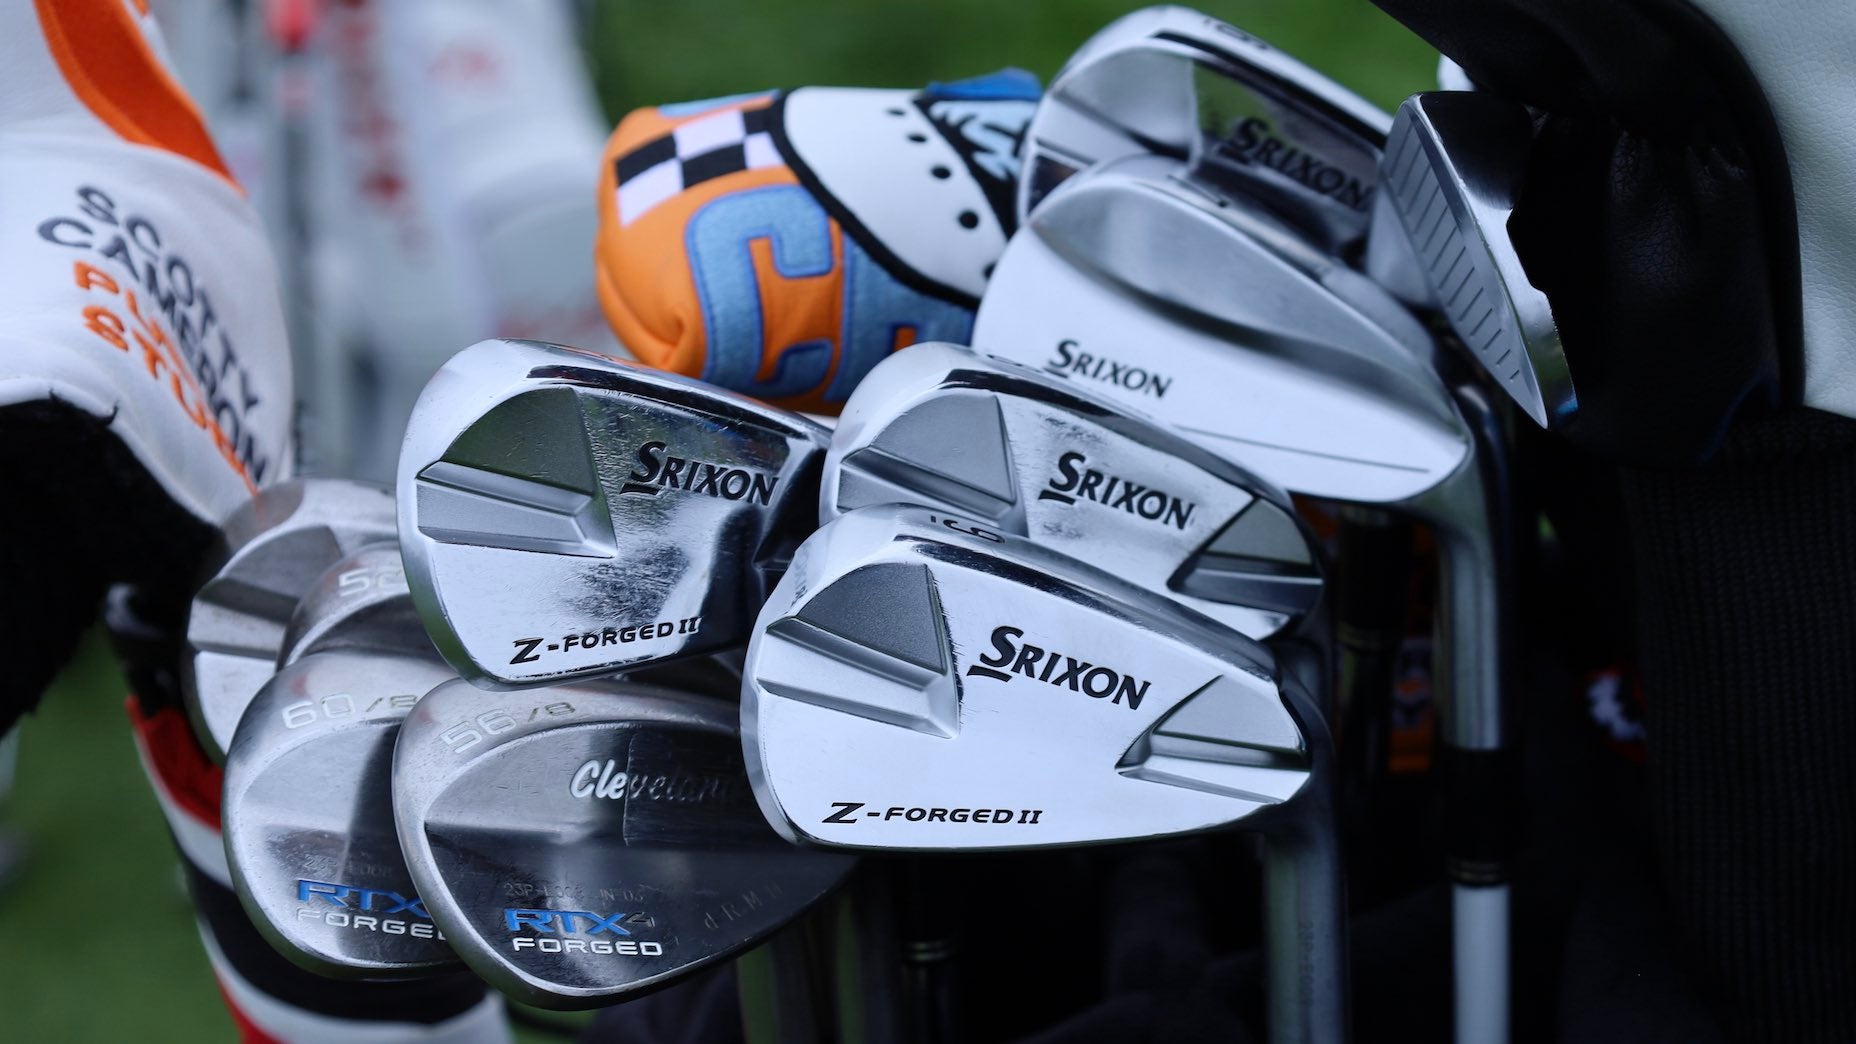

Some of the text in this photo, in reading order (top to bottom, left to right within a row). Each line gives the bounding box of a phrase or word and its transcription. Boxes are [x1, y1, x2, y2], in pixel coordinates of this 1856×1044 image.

[1212, 117, 1376, 212] SRIXON
[77, 185, 259, 416] SCOTTY
[37, 217, 267, 484] CAMERON
[1044, 339, 1172, 399] SRIXON
[619, 441, 778, 506] SRIXON
[1038, 451, 1195, 530] SRIXON
[509, 622, 675, 664] Z-FORGED
[966, 625, 1151, 711] SRIXON
[822, 802, 1014, 824] Z-FORGED
[297, 907, 447, 942] FORGE
[511, 937, 664, 957] FORGED
